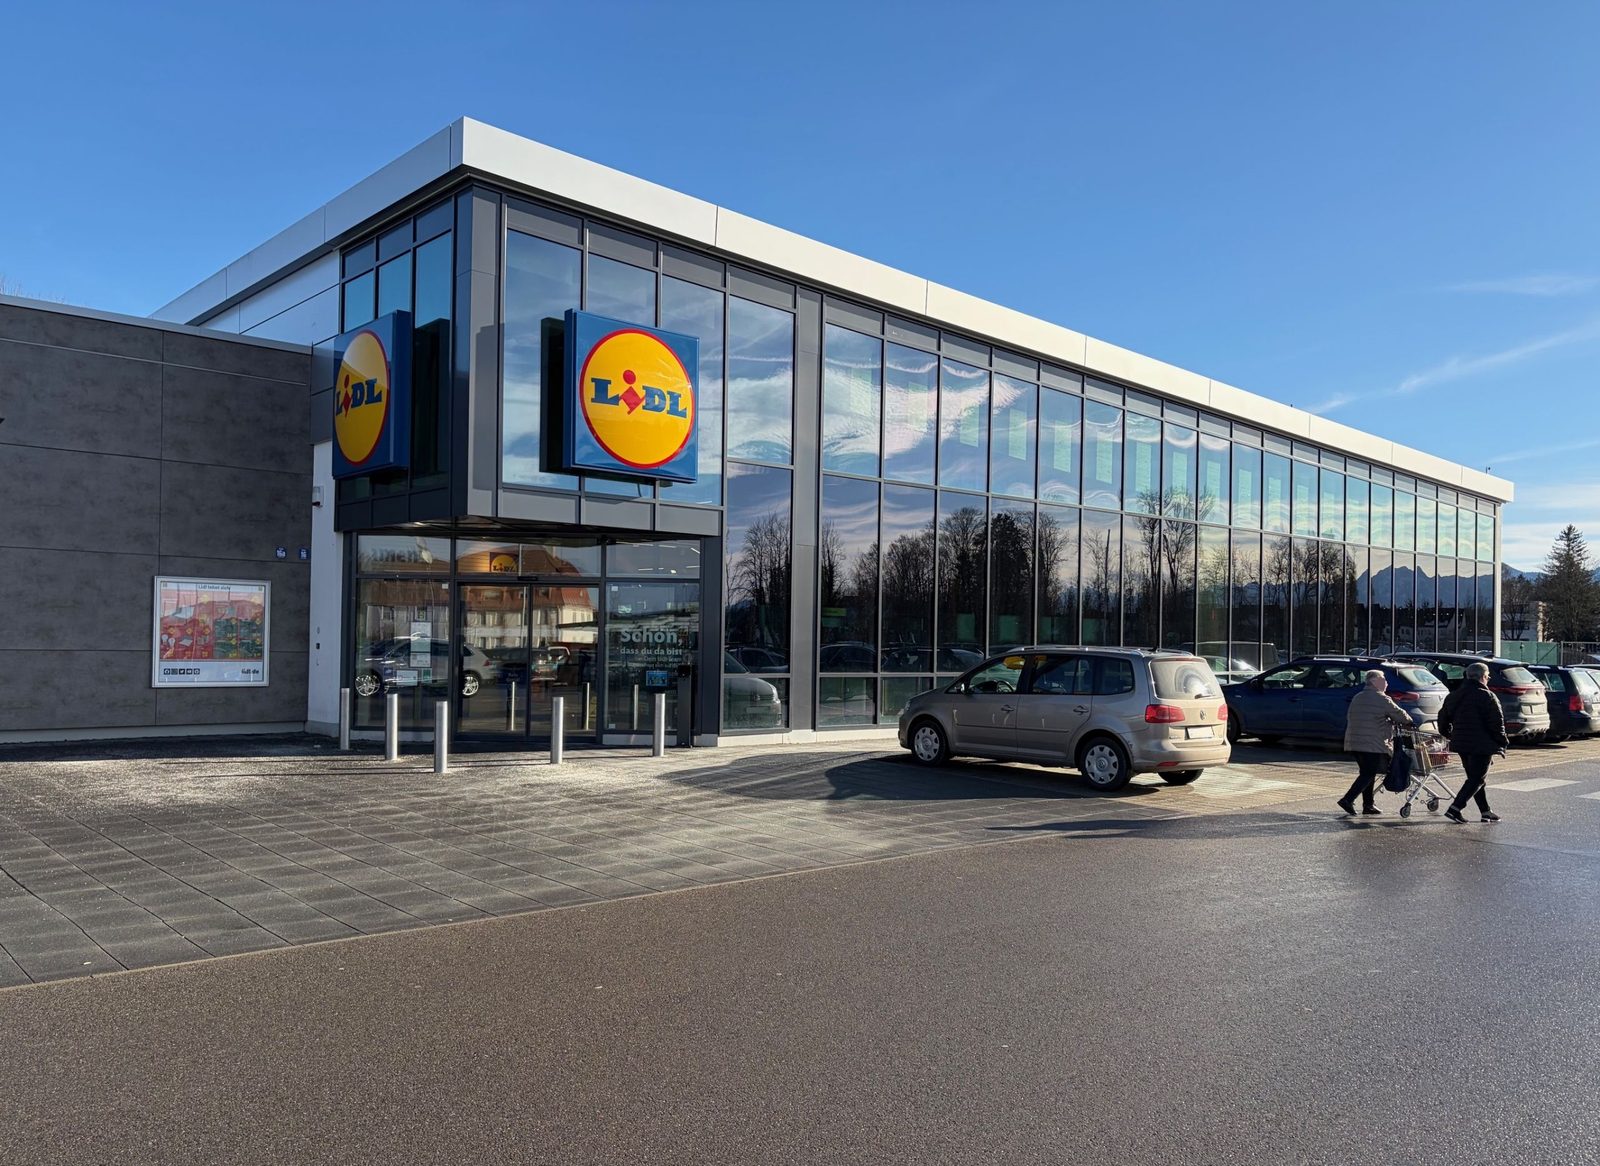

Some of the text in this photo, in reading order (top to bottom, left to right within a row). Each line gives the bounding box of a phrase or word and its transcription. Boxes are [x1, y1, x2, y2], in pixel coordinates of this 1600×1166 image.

[591, 369, 687, 418] LIDL
[641, 647, 652, 655] du
[654, 647, 665, 655] da
[666, 647, 682, 655] bist
